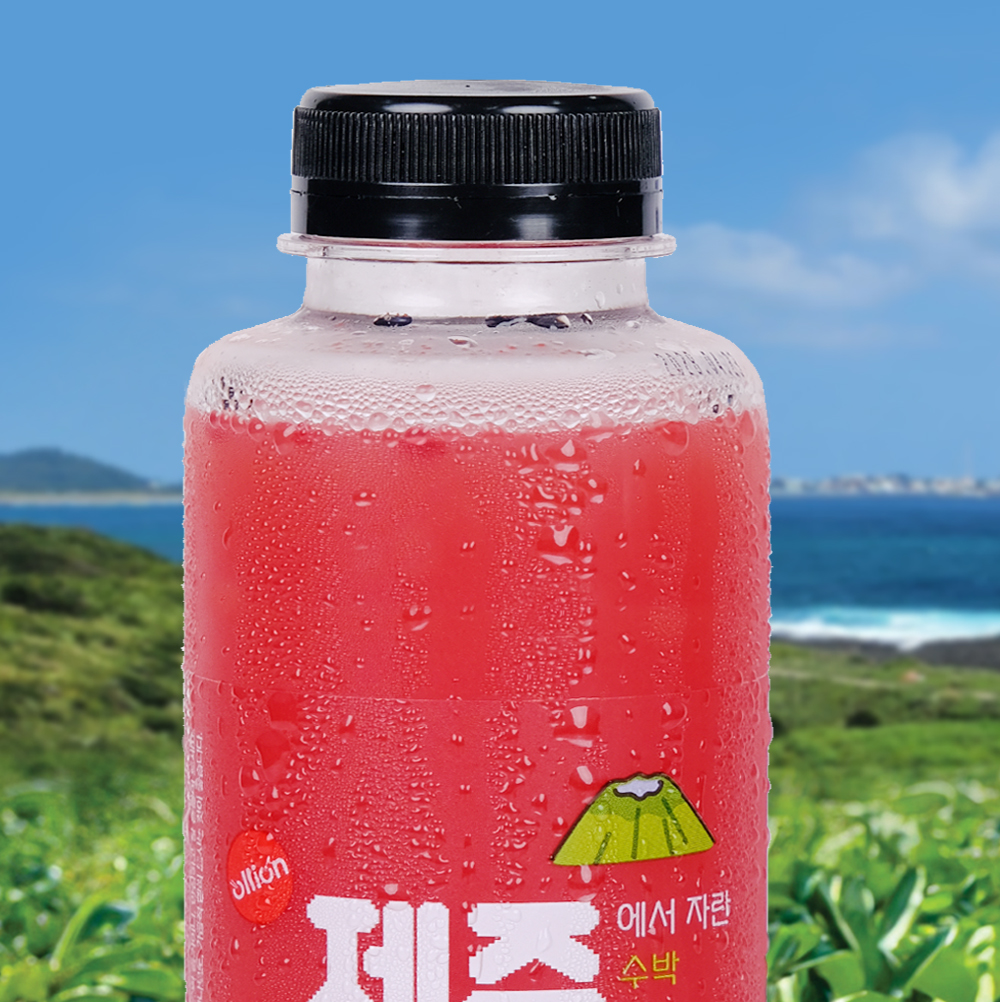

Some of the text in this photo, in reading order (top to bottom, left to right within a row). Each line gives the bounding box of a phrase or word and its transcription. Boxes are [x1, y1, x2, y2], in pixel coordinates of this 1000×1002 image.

[617, 890, 731, 938] 에서 자란
[620, 950, 680, 989] 수박
